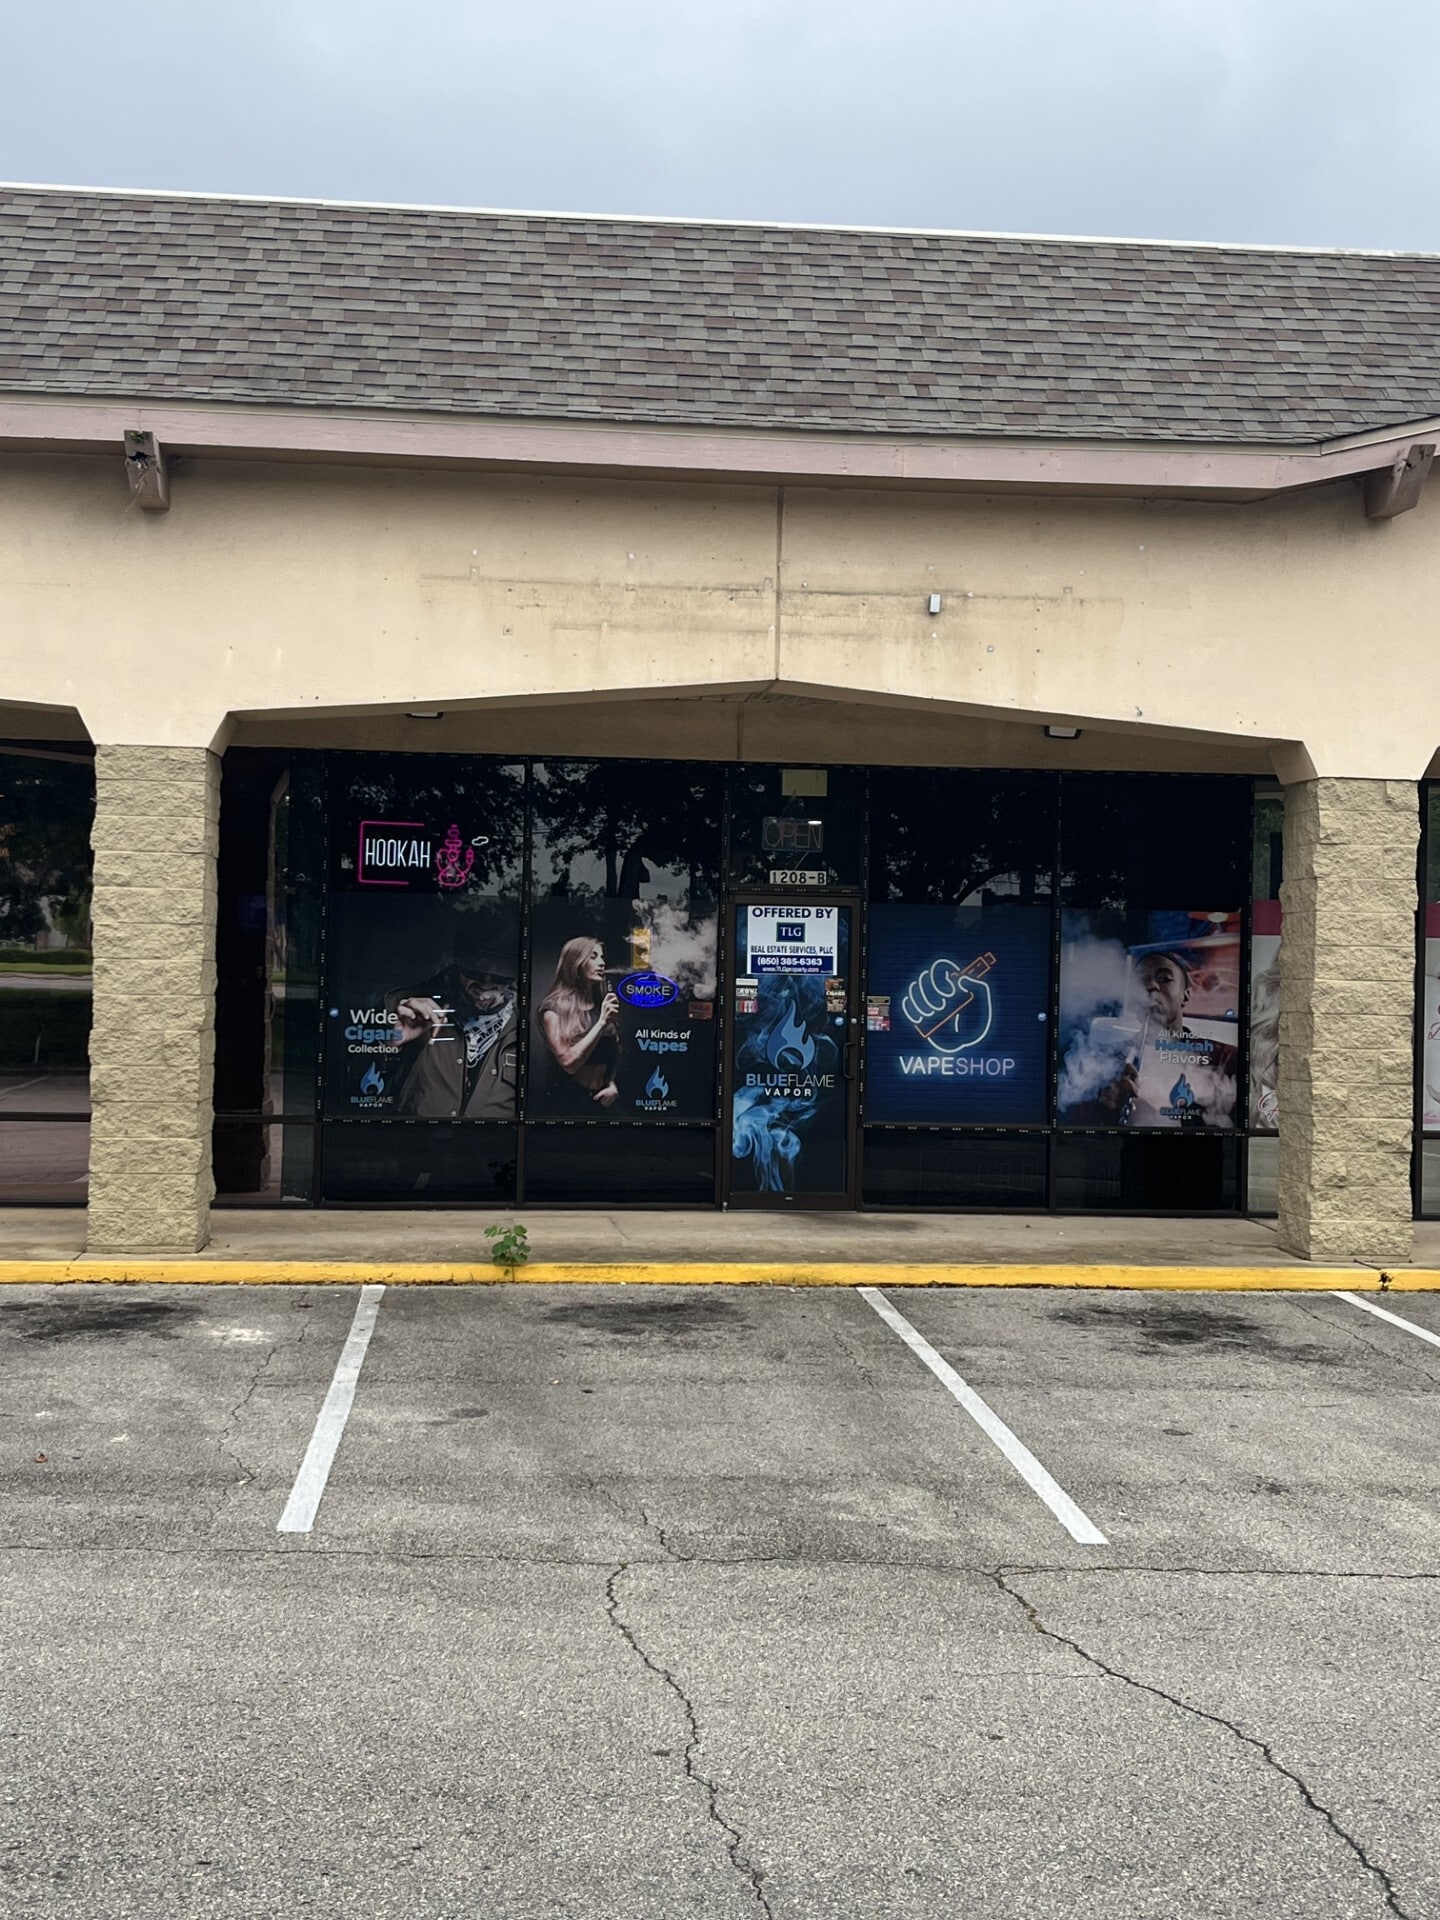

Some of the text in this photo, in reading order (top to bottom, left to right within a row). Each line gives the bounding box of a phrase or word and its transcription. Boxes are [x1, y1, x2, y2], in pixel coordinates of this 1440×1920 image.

[765, 821, 821, 849] OPEN
[365, 838, 431, 868] HOOKAH
[771, 872, 825, 884] 1208-B
[752, 907, 833, 919] OFFERED BY
[780, 927, 802, 937] TLG
[751, 945, 765, 953] REAL
[767, 945, 788, 954] ESTATE
[820, 946, 833, 954] PLLC
[626, 984, 671, 996] SMOKE
[350, 1009, 398, 1024] Wide
[344, 1025, 403, 1043] Cigars
[635, 1029, 691, 1039] All Kinds of
[347, 1044, 399, 1053] Collection
[637, 1039, 688, 1054] Vapes
[1154, 1040, 1214, 1051] Hookah
[1160, 1052, 1210, 1065] Flavors
[746, 1073, 836, 1088] BLUEFLAME
[765, 1088, 812, 1097] VAPOR
